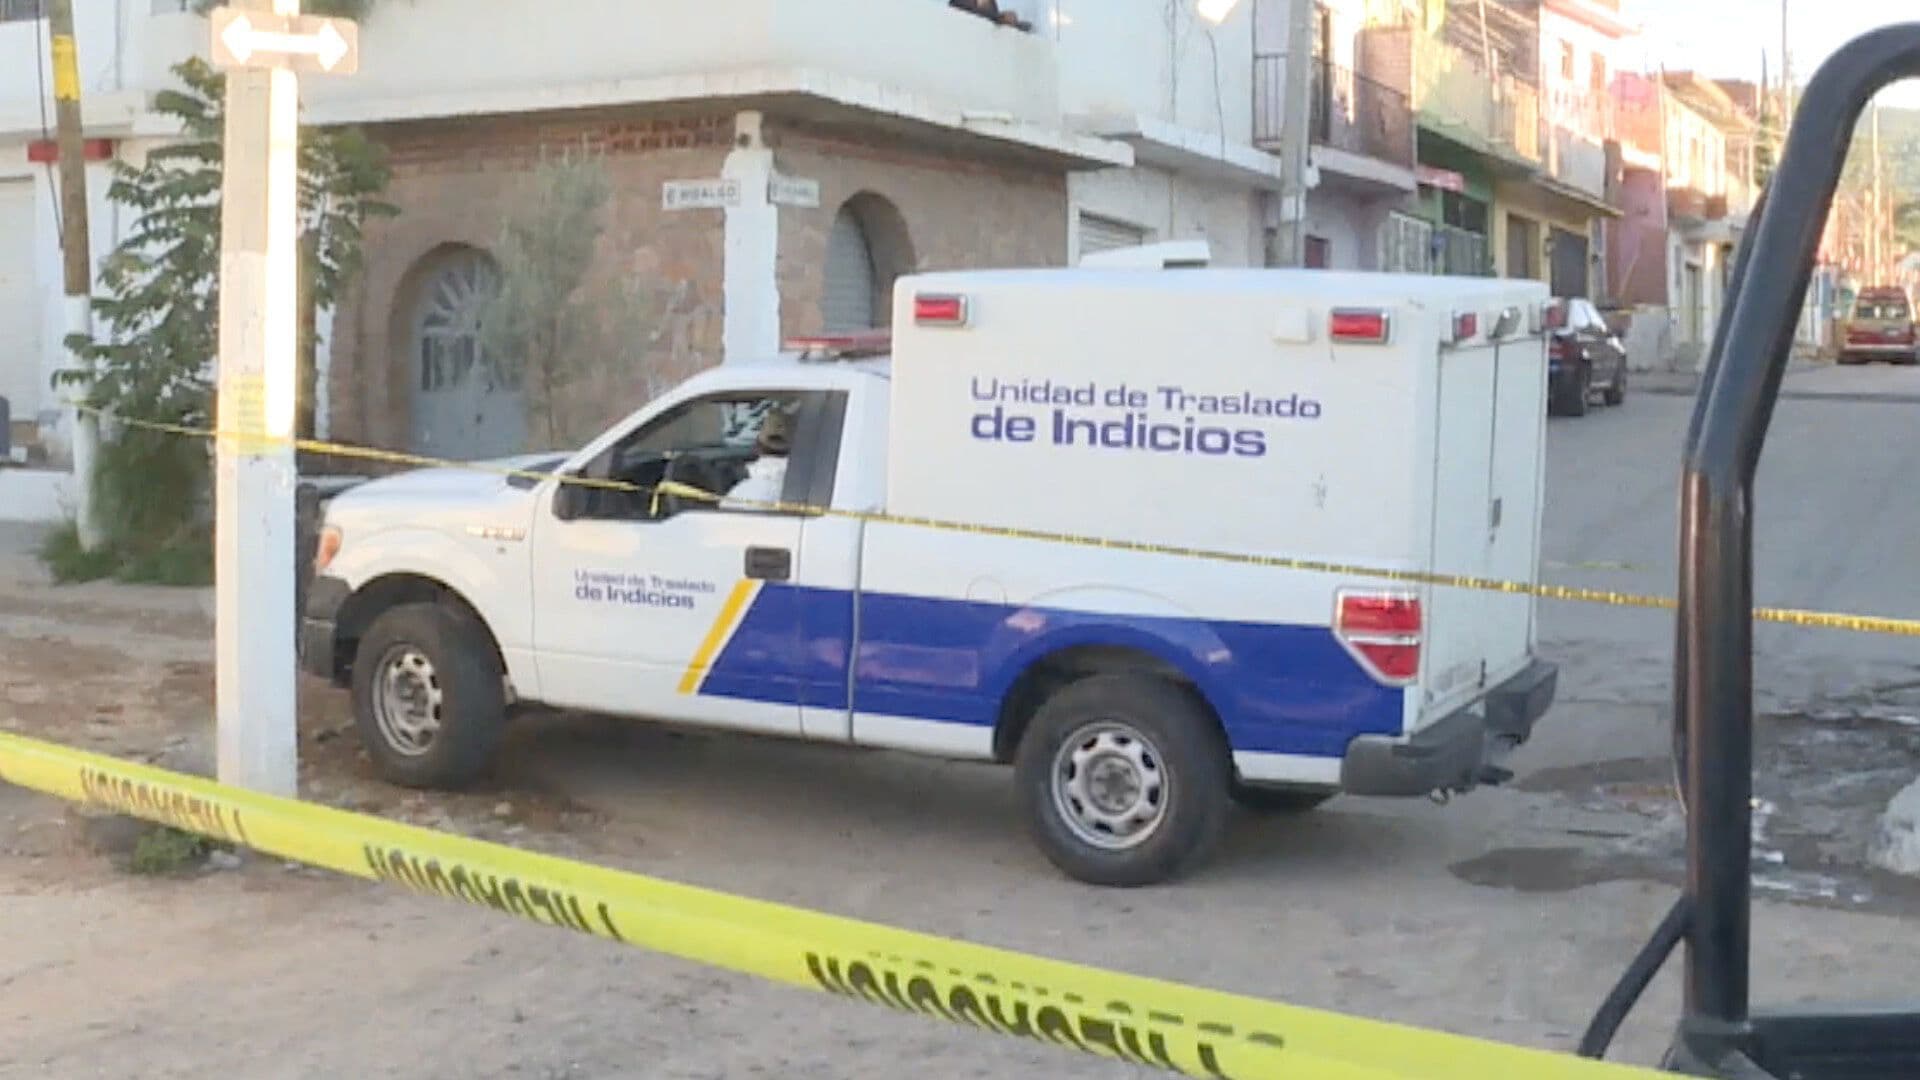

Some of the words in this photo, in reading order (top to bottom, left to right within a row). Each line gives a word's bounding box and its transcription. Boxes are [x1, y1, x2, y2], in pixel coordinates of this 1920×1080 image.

[971, 376, 1095, 406] Unidad
[1105, 384, 1147, 408] de
[1157, 386, 1322, 419] Traslado
[971, 406, 1035, 442] de
[1052, 409, 1267, 457] Indicios
[574, 569, 625, 585] Unidad
[628, 574, 645, 586] de
[650, 575, 716, 593] Traslado
[575, 584, 602, 600] de
[607, 585, 695, 609] Indicios
